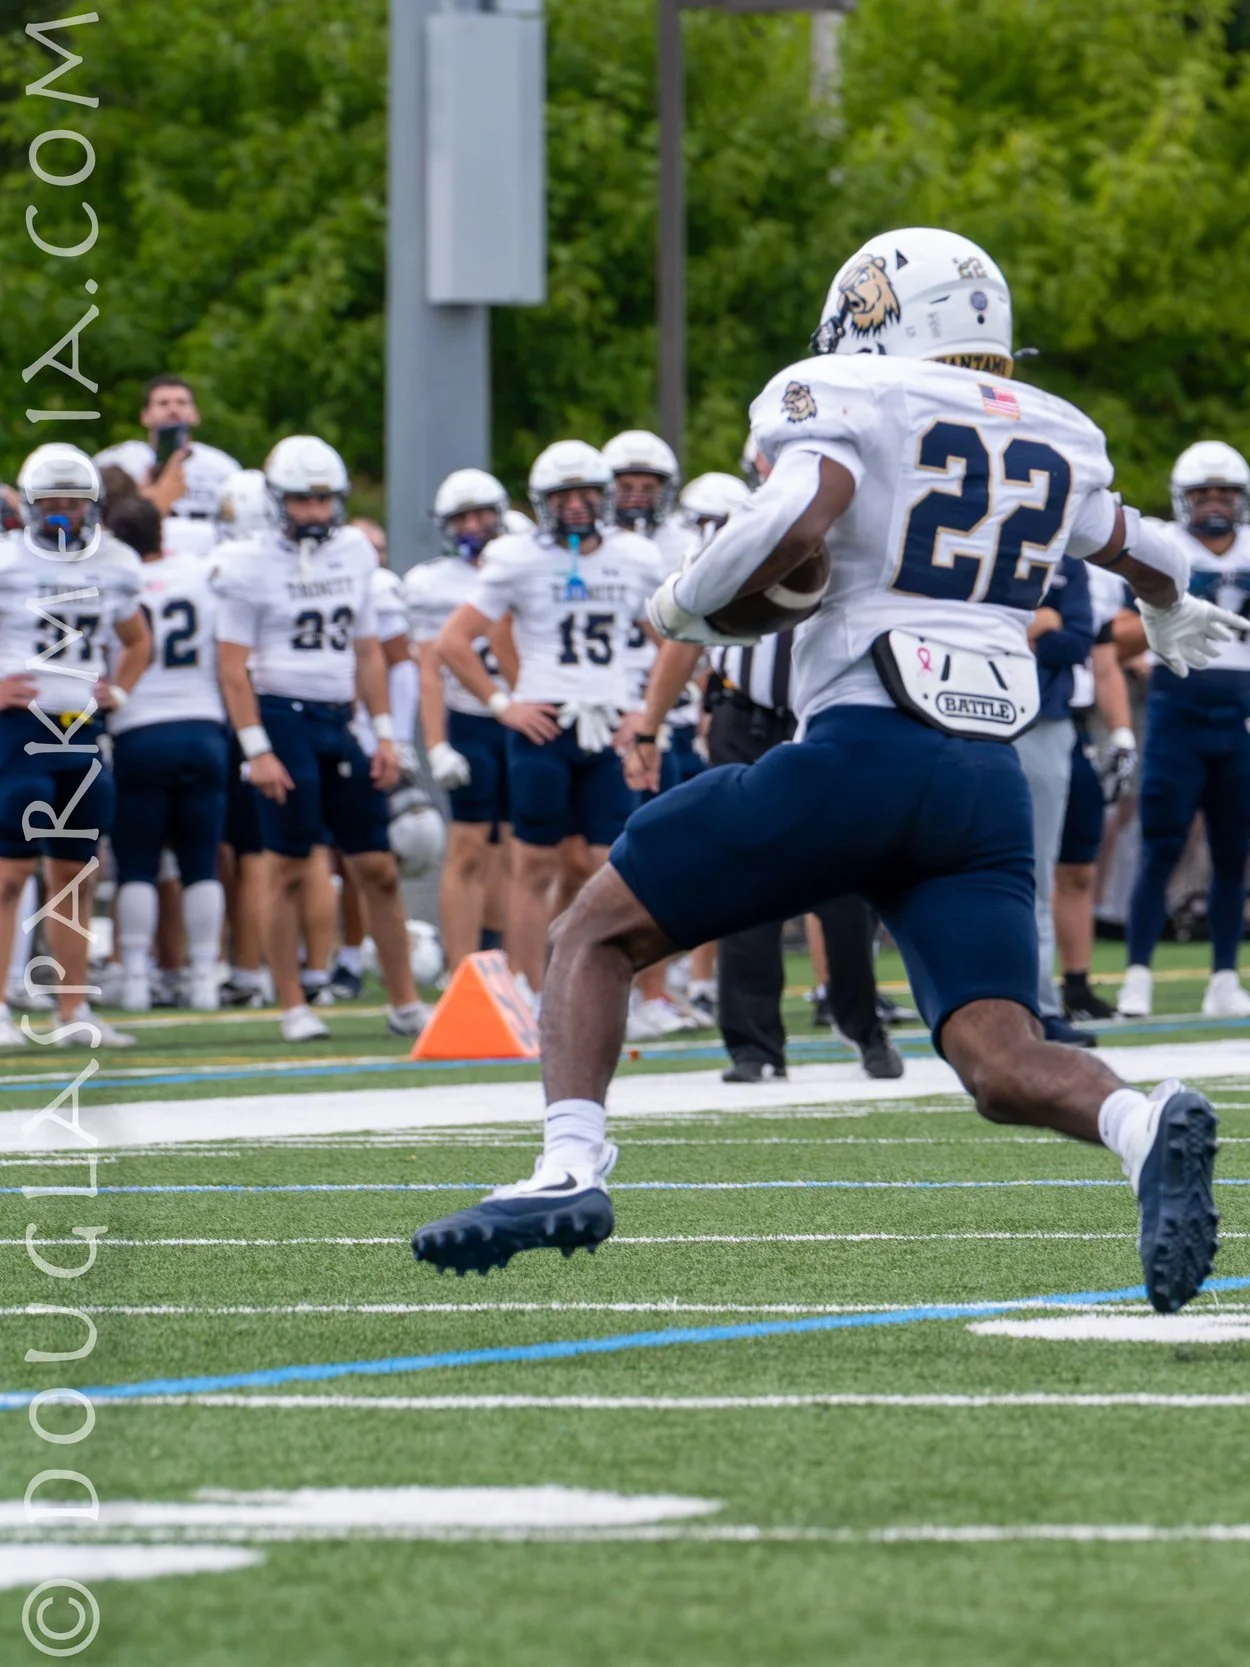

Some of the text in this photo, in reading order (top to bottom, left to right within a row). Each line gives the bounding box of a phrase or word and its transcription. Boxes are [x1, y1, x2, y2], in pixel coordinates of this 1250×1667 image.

[888, 420, 1073, 610] 22
[34, 612, 101, 662] 37
[291, 605, 354, 652] 23
[558, 612, 616, 667] 15
[944, 697, 1010, 720] BATTLE
